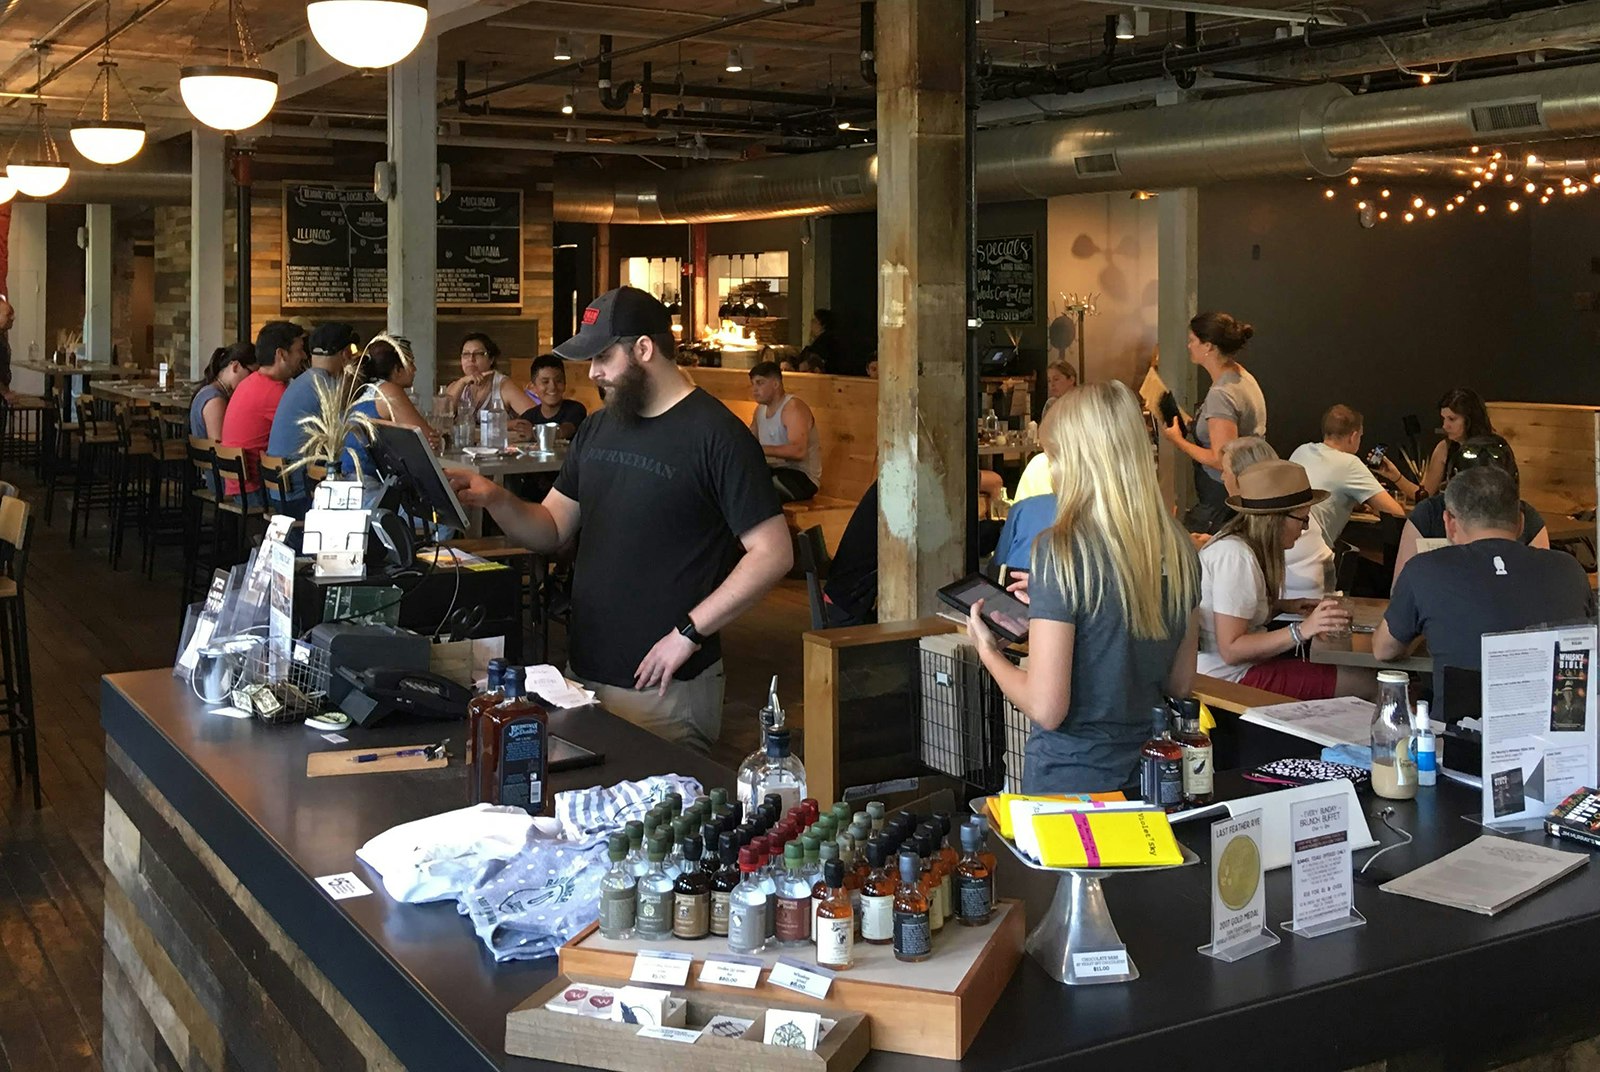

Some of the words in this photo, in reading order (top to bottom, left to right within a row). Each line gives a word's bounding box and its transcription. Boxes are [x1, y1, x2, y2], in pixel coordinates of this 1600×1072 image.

[460, 196, 496, 207] MICHIGAN
[297, 227, 331, 240] ILLINOIS
[469, 245, 500, 257] INDIANA
[1558, 653, 1585, 661] WHISKY
[1559, 661, 1584, 669] BIBLE
[1320, 805, 1337, 815] SUNDAY
[1299, 816, 1320, 828] BRUNCH
[1321, 811, 1340, 823] BUFFET
[1215, 826, 1229, 839] LAST
[1229, 819, 1250, 833] FEATHER
[1250, 816, 1260, 827] RYE
[1230, 913, 1244, 926] GOLD
[1243, 908, 1259, 920] MEDAL
